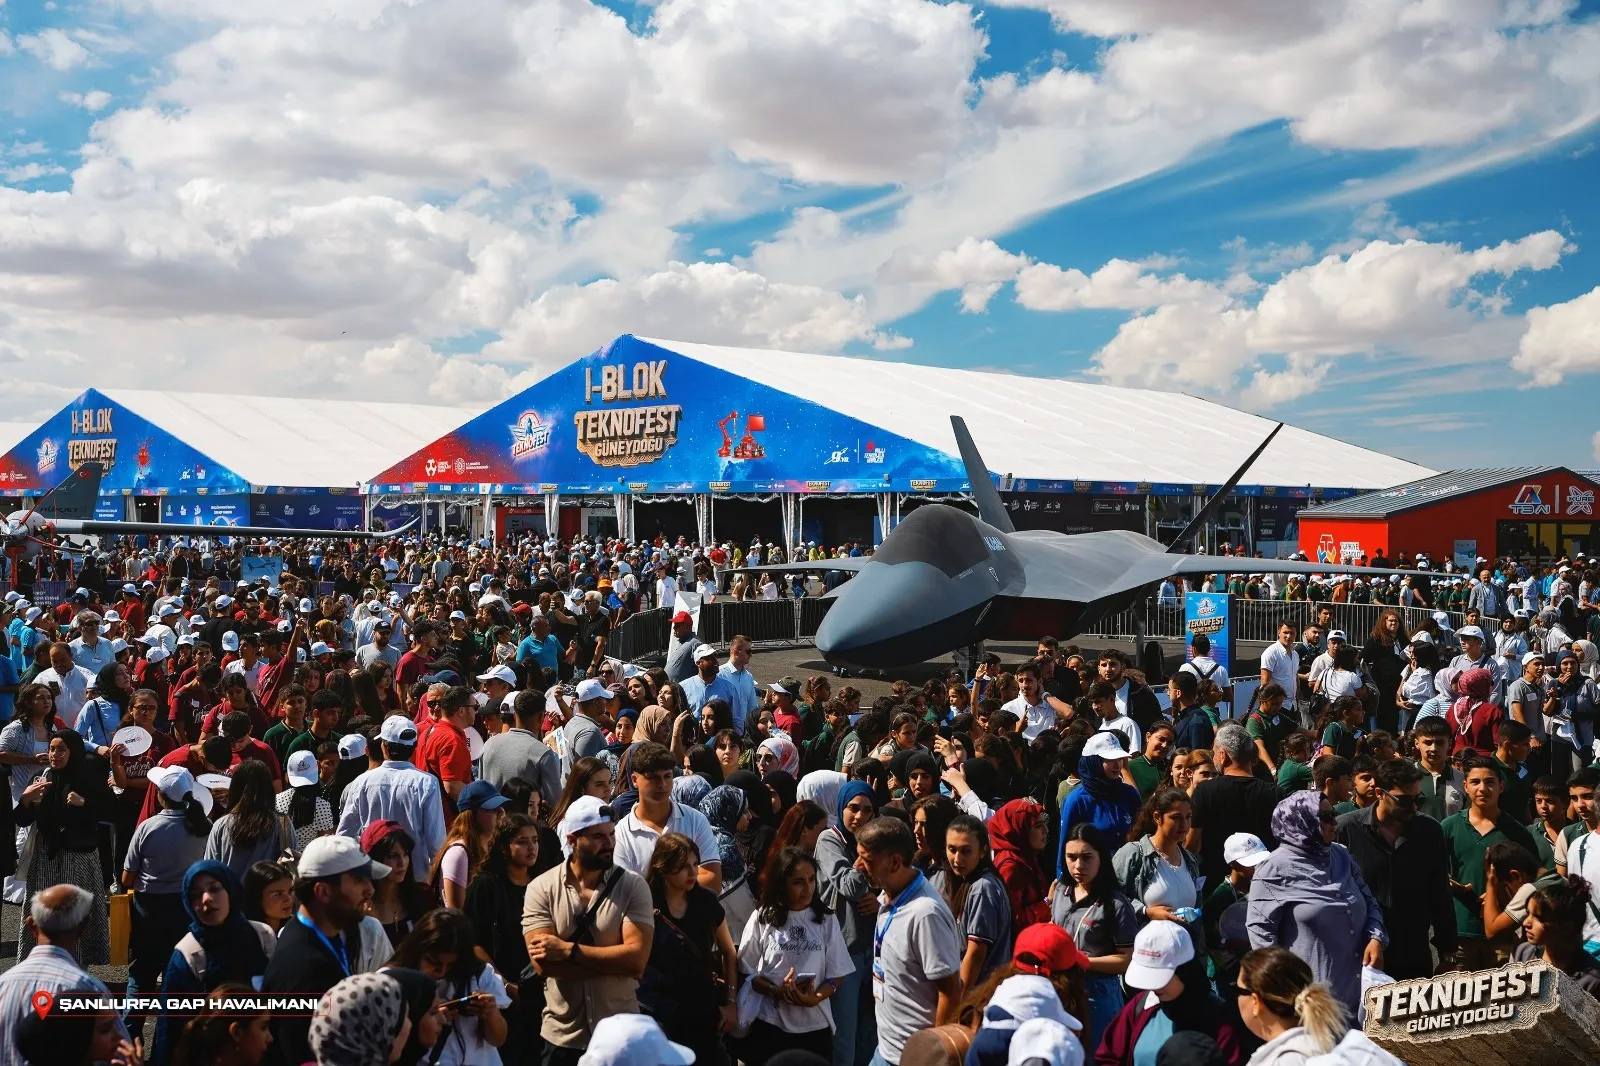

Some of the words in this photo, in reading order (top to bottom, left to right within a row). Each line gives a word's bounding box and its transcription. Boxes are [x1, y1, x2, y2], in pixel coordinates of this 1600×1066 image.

[585, 359, 668, 403] I-BLOK
[71, 408, 113, 434] H-BLOK
[575, 405, 682, 440] TEKNOFEST
[68, 439, 117, 460] TEKNOFEST
[511, 432, 550, 457] TEKNOFEST
[595, 436, 663, 458] GÜNEYDOĞU
[1187, 616, 1225, 628] TEKNOFEST
